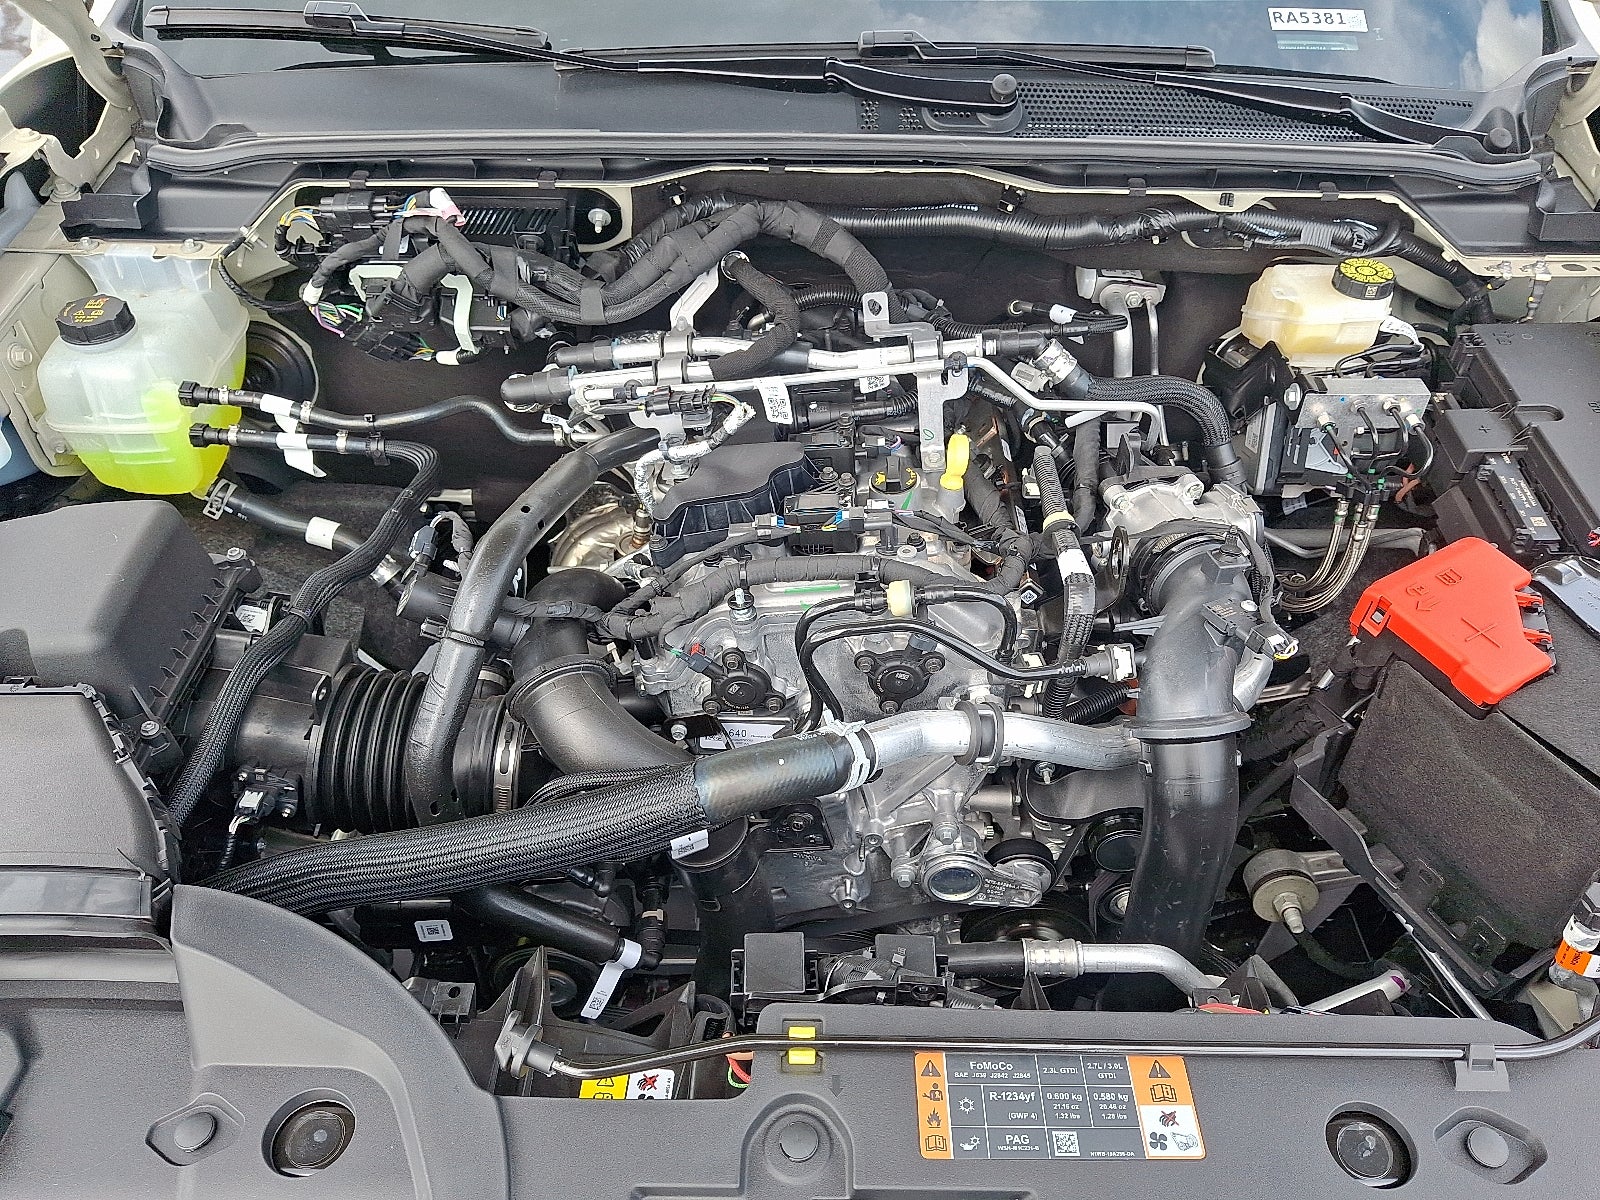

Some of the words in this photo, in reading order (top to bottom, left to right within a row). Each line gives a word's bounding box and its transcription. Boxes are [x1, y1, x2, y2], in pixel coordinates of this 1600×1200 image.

[1273, 11, 1347, 24] RA5381
[970, 1062, 1014, 1070] FoMoCo
[990, 1092, 1036, 1103] R-1234yf
[1072, 1093, 1082, 1102] kg
[1118, 1093, 1129, 1102] kg
[1006, 1135, 1030, 1144] PAG
